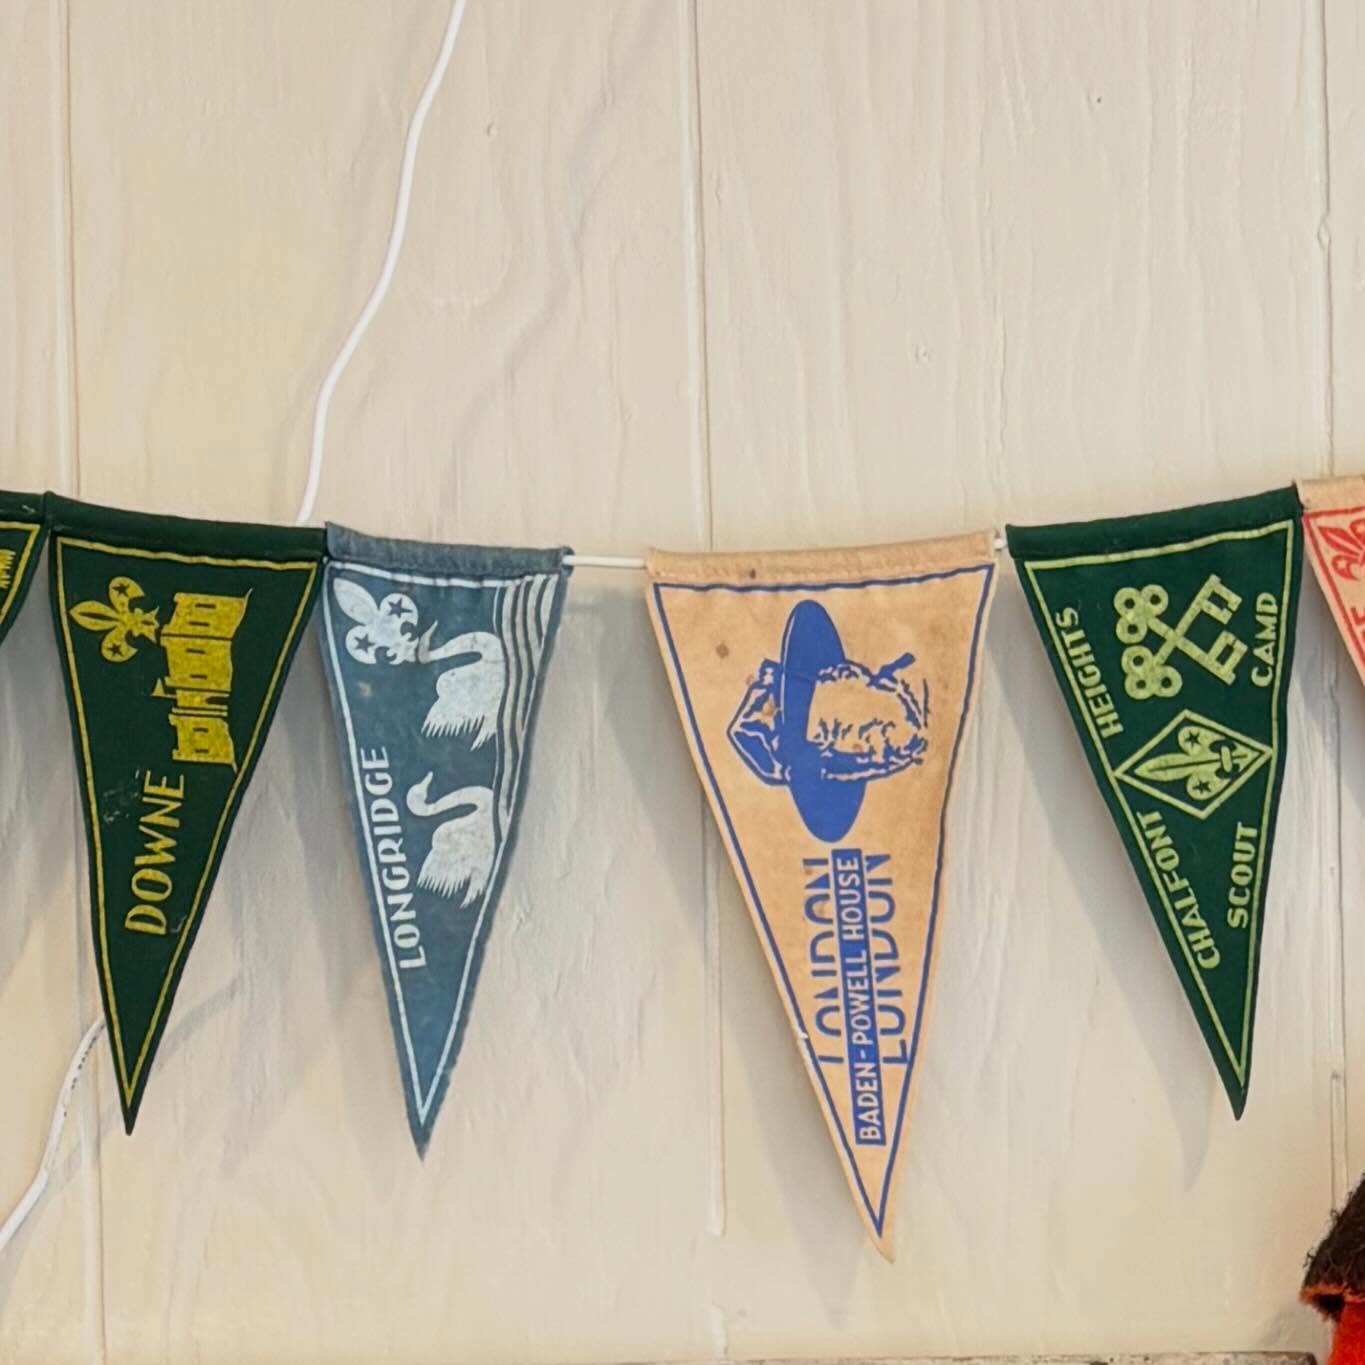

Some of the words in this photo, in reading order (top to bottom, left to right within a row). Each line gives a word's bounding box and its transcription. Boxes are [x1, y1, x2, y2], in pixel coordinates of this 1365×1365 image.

[1055, 606, 1124, 738] HEIGHTS
[124, 770, 186, 936] DOWNE
[361, 745, 425, 969] LONGRIDGE
[835, 857, 866, 940] HOUSE
[1137, 810, 1220, 969] CHALFONT
[1226, 822, 1258, 929] SCOUT
[844, 950, 881, 1142] BADEN-POWELL
